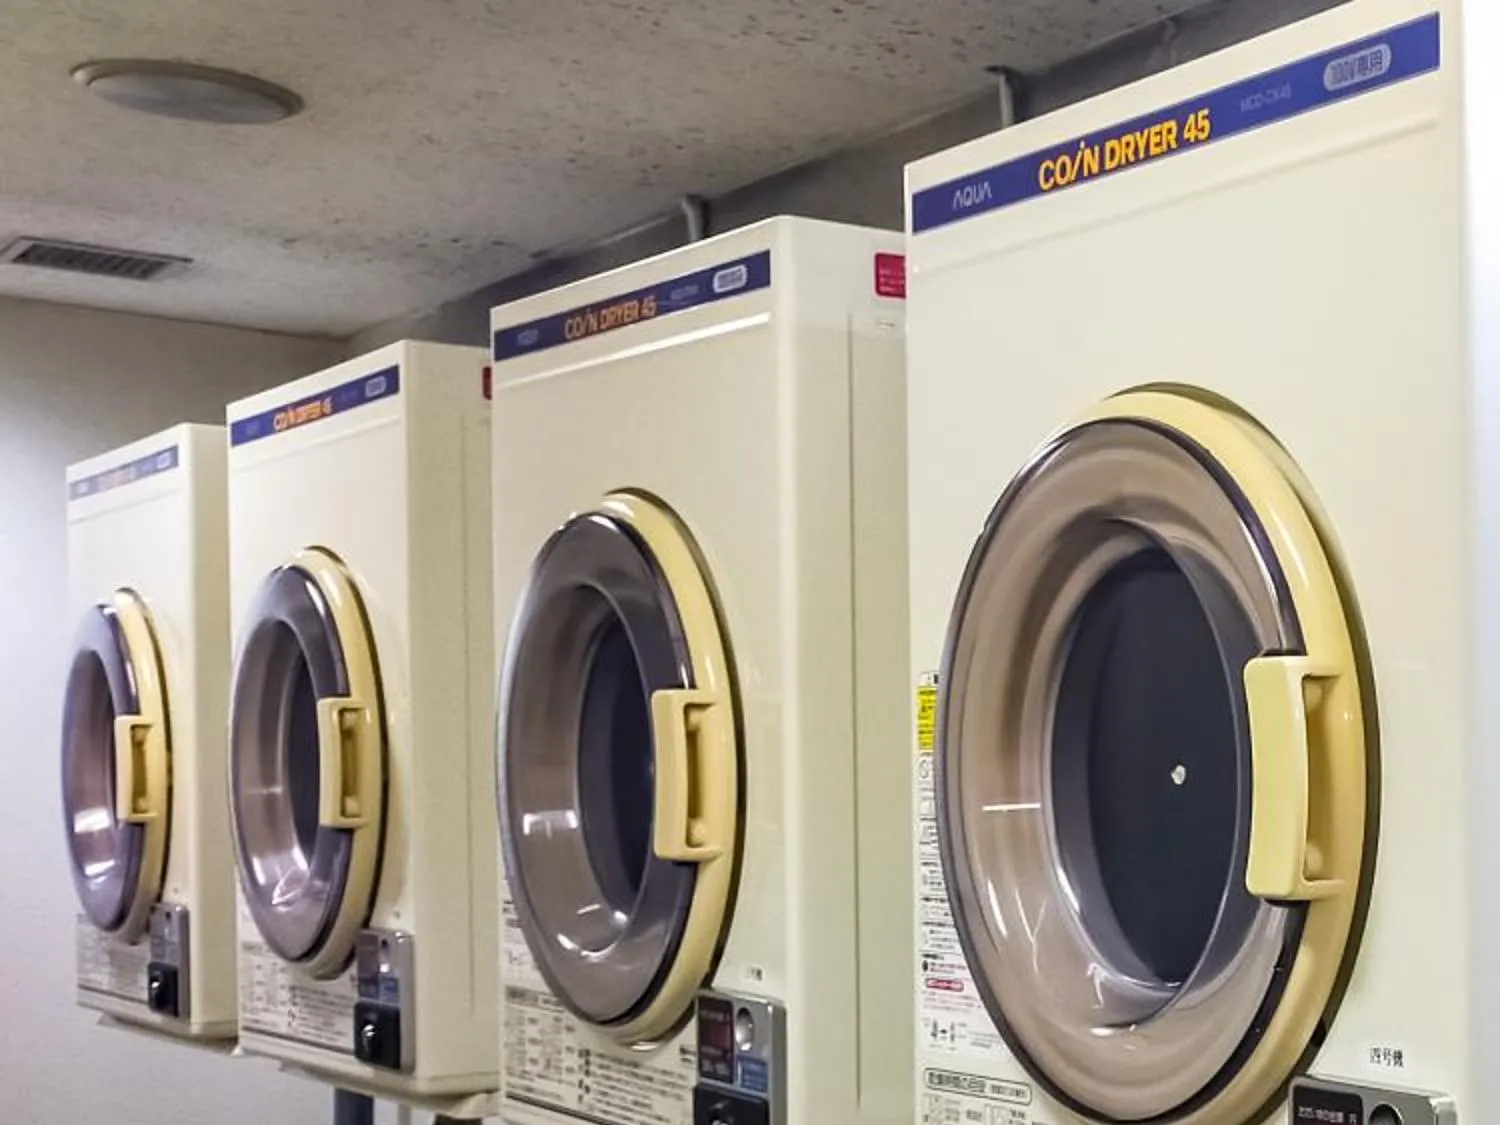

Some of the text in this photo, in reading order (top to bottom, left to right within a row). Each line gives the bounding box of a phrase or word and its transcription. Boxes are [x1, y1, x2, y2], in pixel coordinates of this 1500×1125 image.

[953, 180, 993, 210] AQUA
[1104, 118, 1179, 172] DRYER
[1182, 107, 1212, 143] 45
